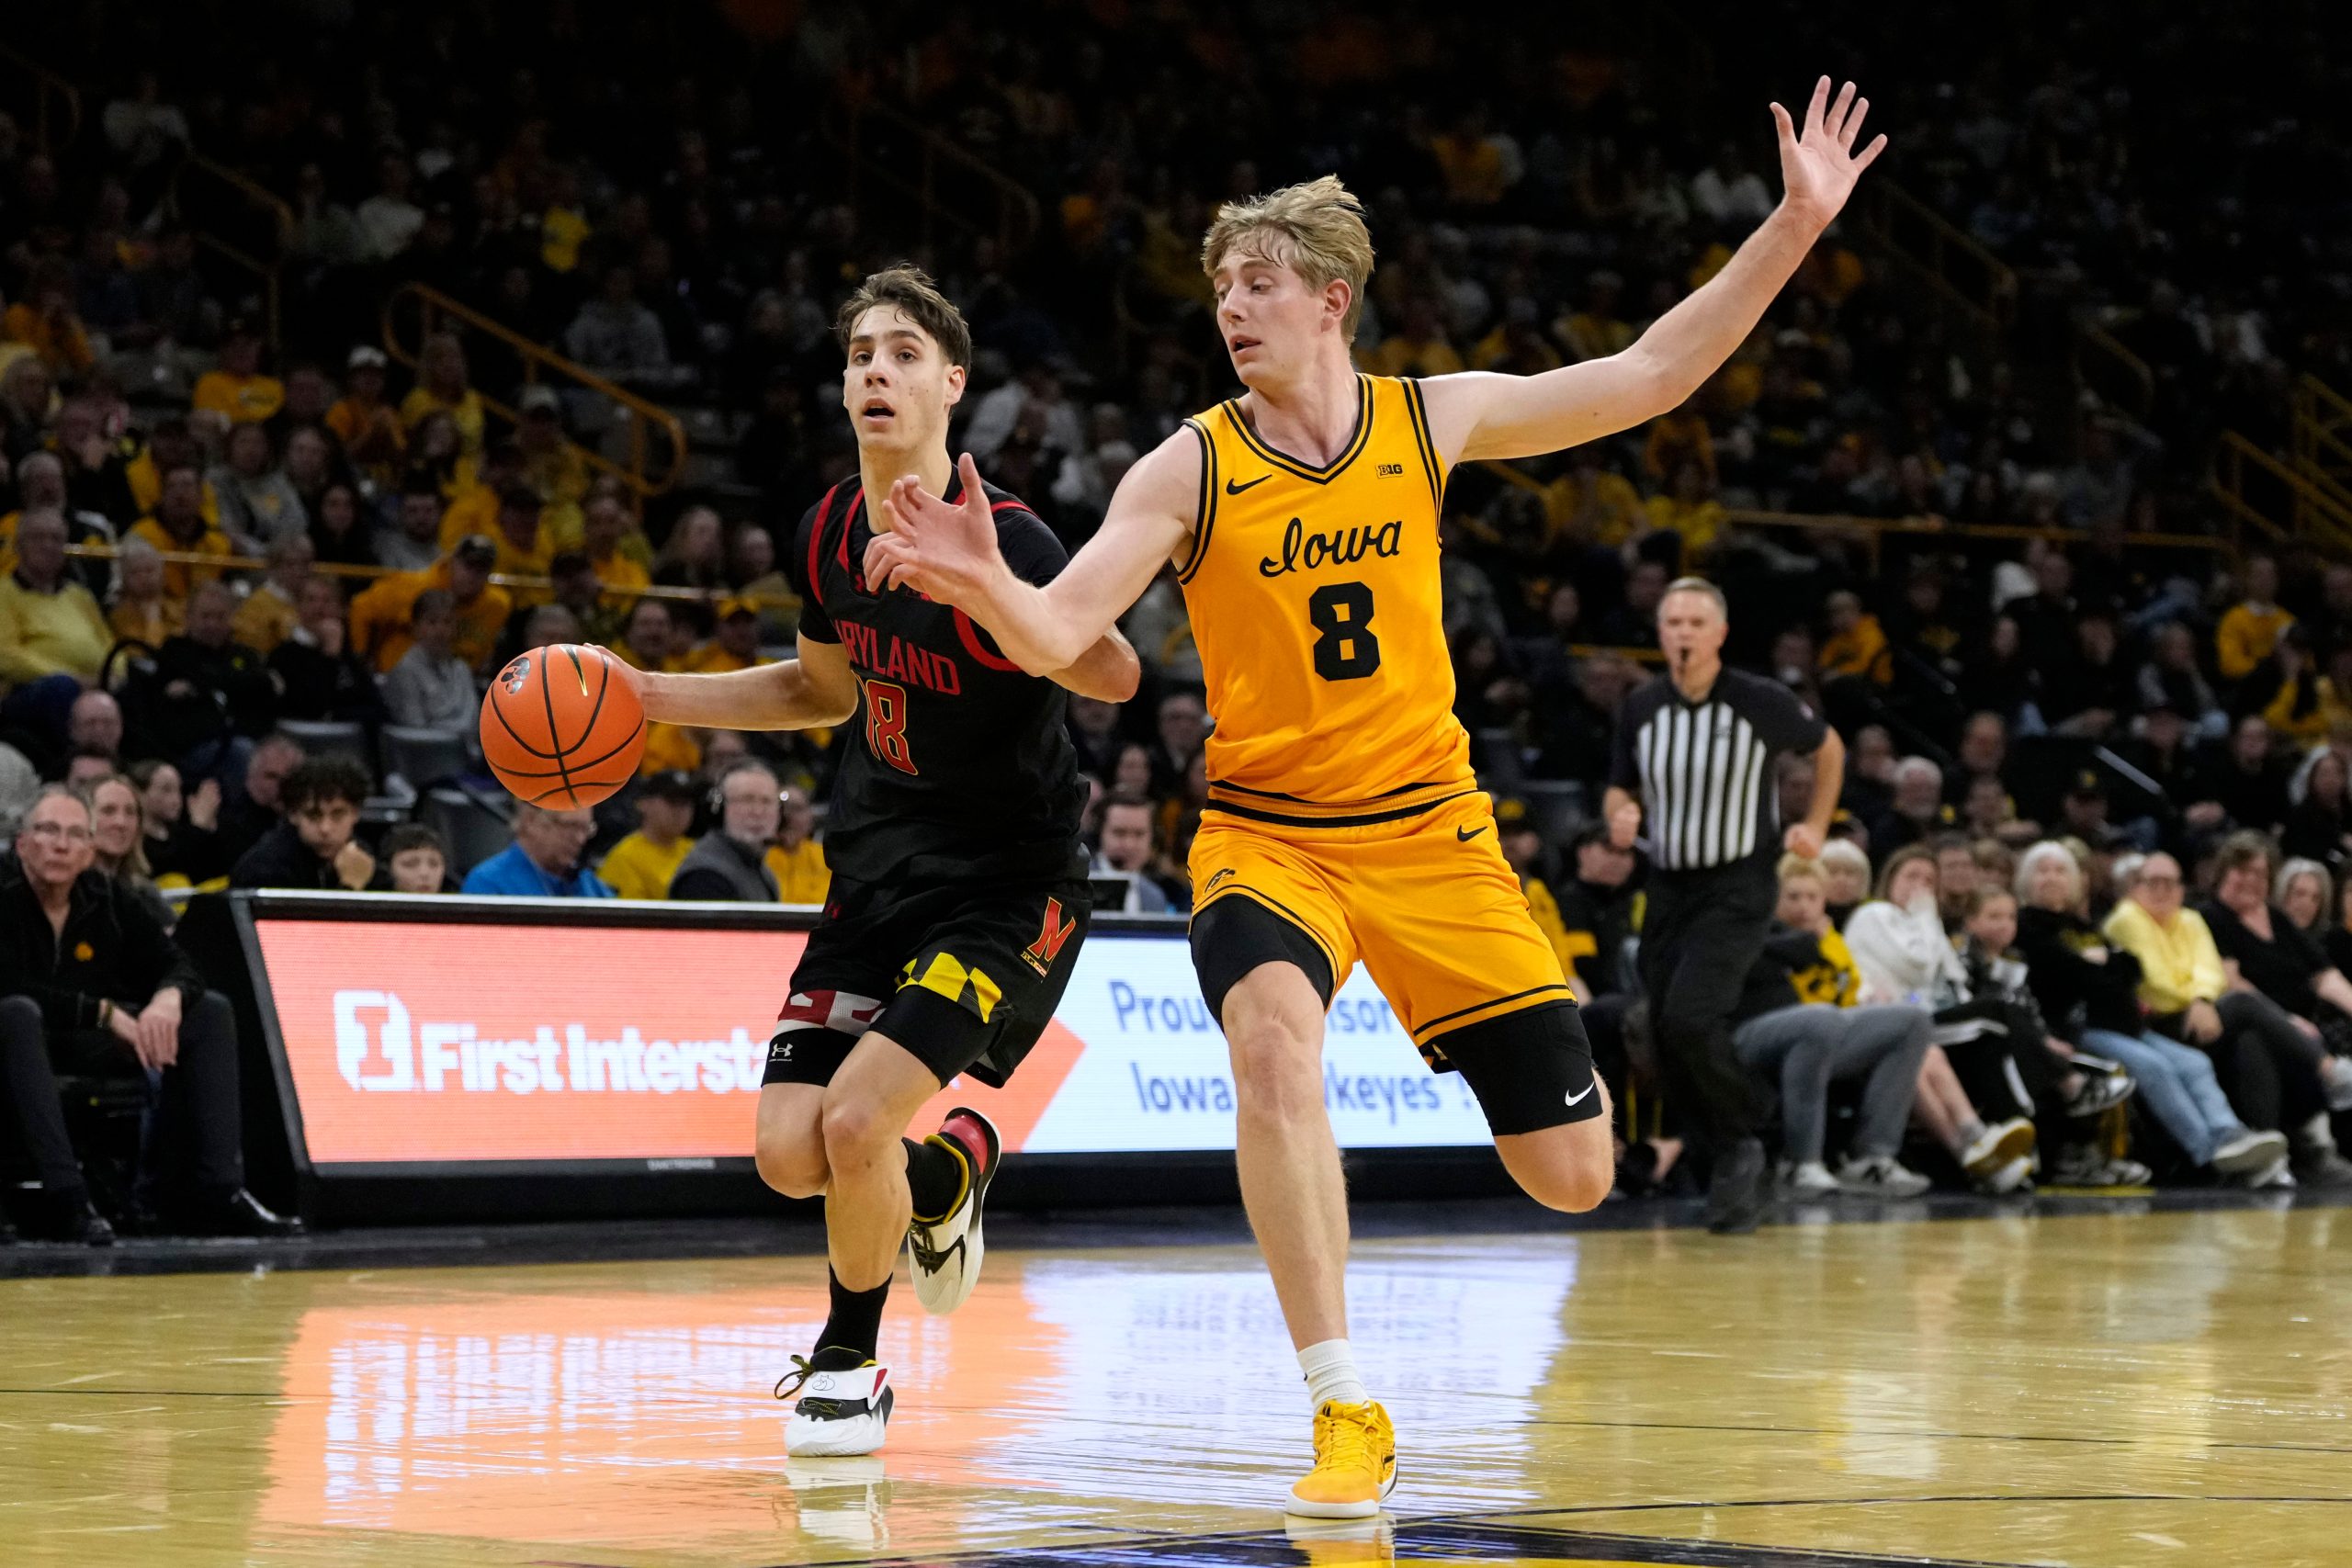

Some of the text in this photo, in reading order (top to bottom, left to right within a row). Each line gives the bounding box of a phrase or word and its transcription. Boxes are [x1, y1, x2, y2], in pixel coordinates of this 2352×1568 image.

[1260, 517, 1402, 578] Iowa
[834, 619, 961, 695] RYLAND
[1308, 581, 1381, 682] 8
[1108, 979, 1209, 1032] Prou
[420, 1022, 564, 1095] First
[1128, 1062, 1234, 1112] Iowa
[1324, 1061, 1441, 1126] keyes
